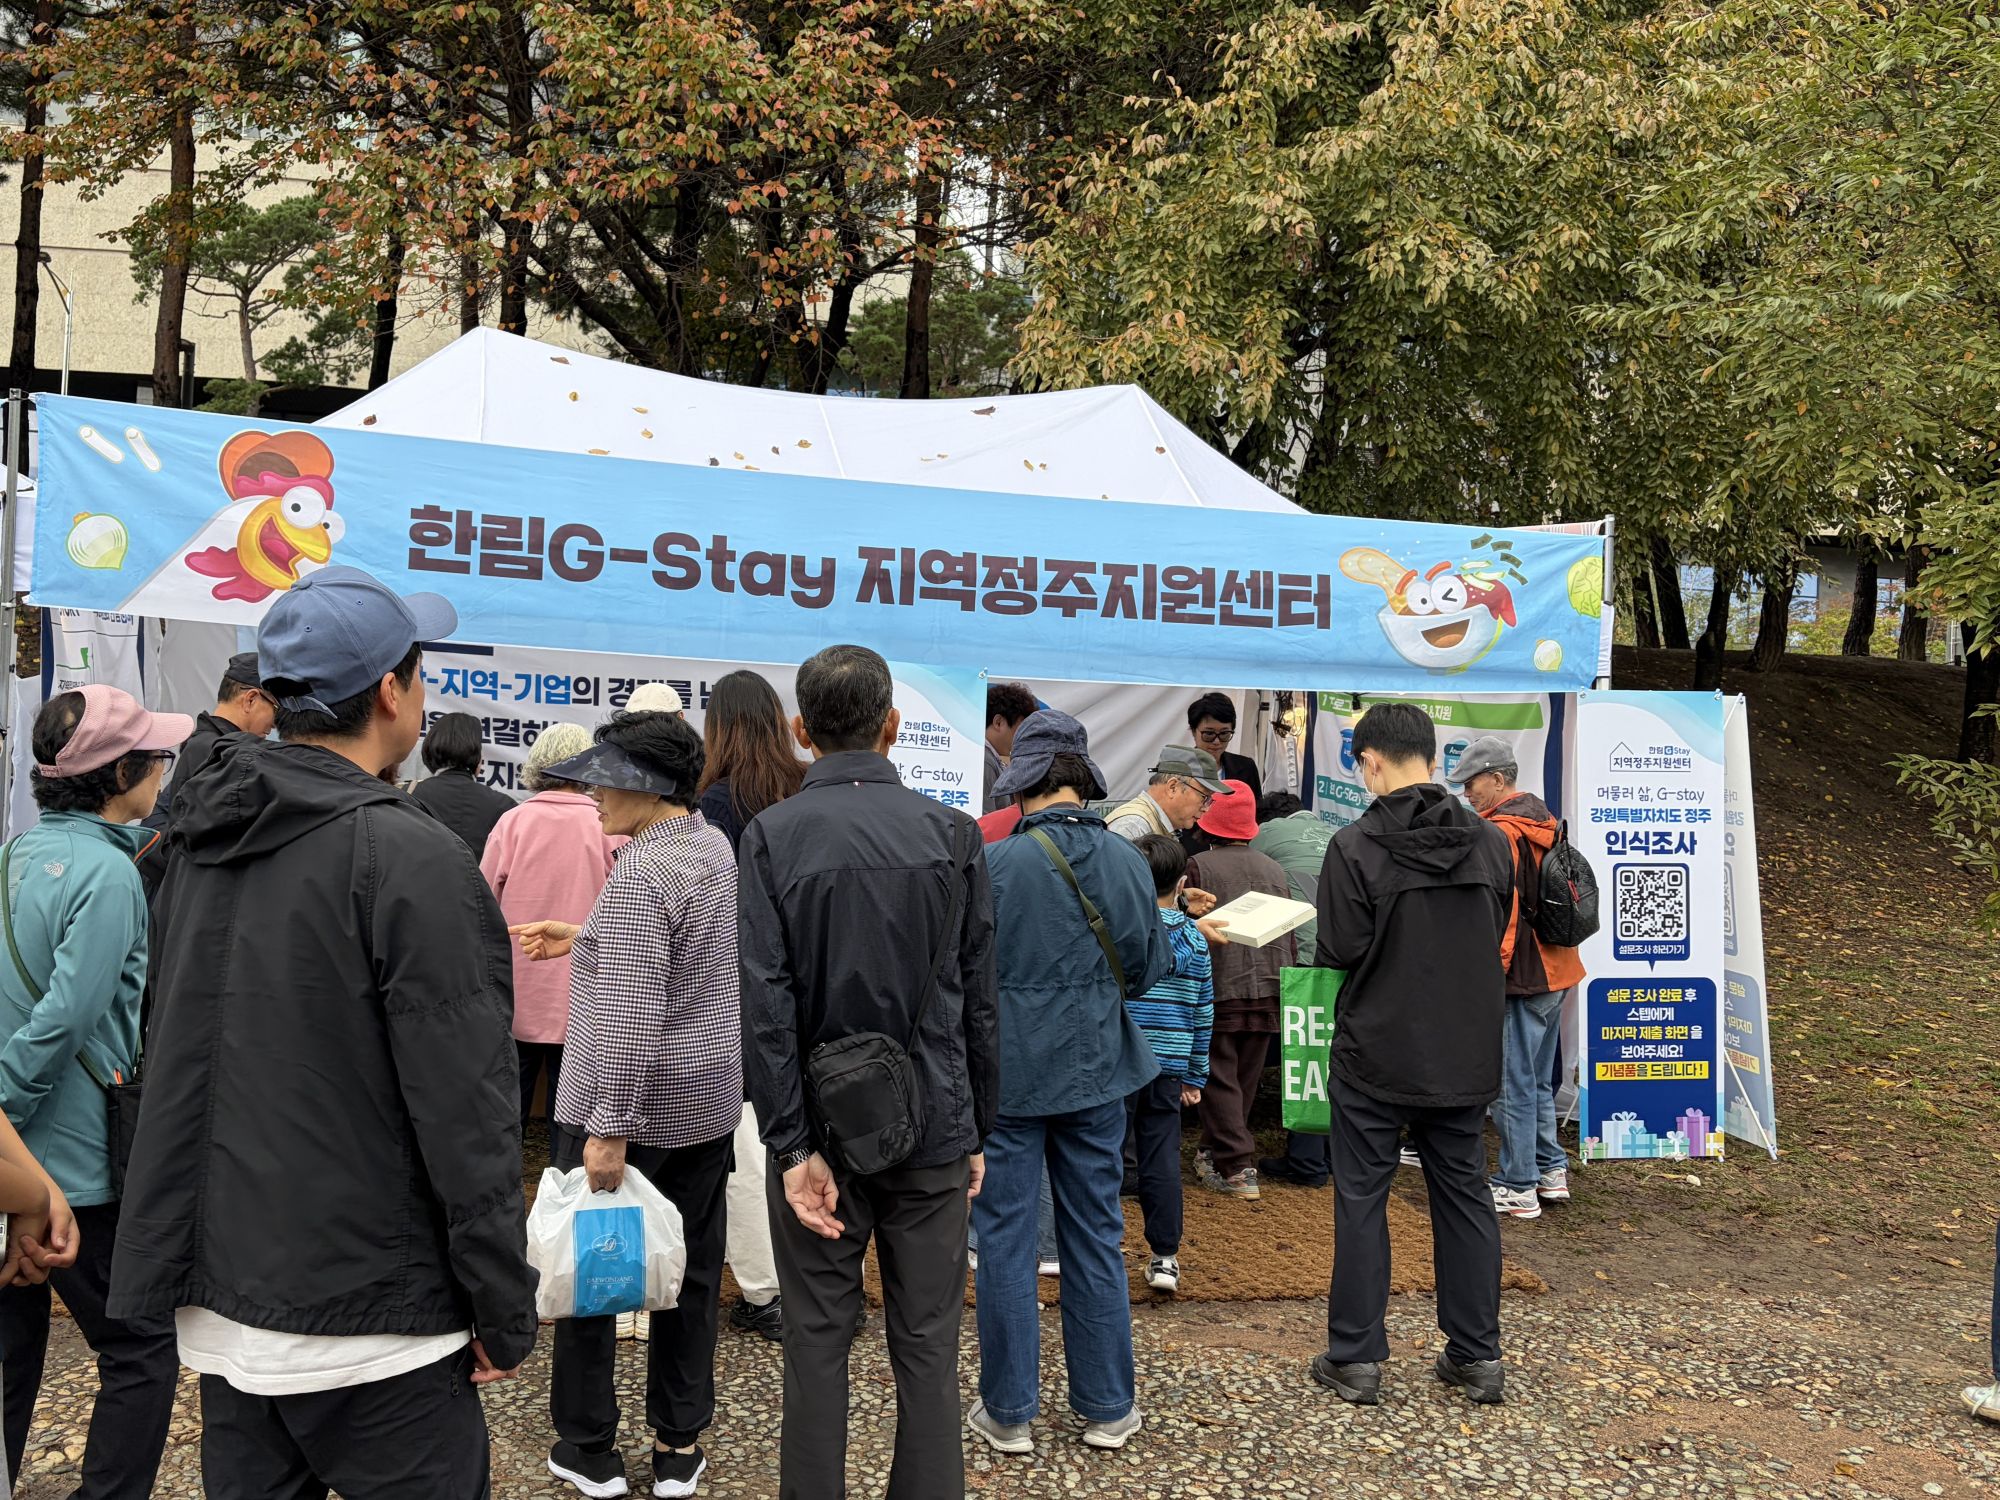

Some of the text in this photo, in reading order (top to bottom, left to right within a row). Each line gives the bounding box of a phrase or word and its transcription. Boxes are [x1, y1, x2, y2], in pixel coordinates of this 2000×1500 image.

[408, 504, 1331, 629] 한림G-Stay 지역정주지원센터
[420, 665, 600, 706] -지역-기업의
[608, 677, 692, 709] 경를
[1613, 757, 1691, 769] 지역정주지원센터
[911, 765, 963, 786] G-stay
[1597, 785, 1705, 804] 머물러 삶, G-stay
[1590, 808, 1712, 823] 강원특별자치도 정주
[1605, 830, 1697, 855] 인식조사
[1619, 944, 1685, 955] 설문조사 하러가기
[1606, 988, 1697, 1003] 설문 조사 완료 후
[1627, 1007, 1675, 1022] 스텝에게
[1601, 1025, 1703, 1040] 마지막 제출 화면 을
[1620, 1045, 1684, 1059] 보여주세요!
[1601, 1063, 1648, 1078] 기념품을
[1284, 1059, 1330, 1102] EA
